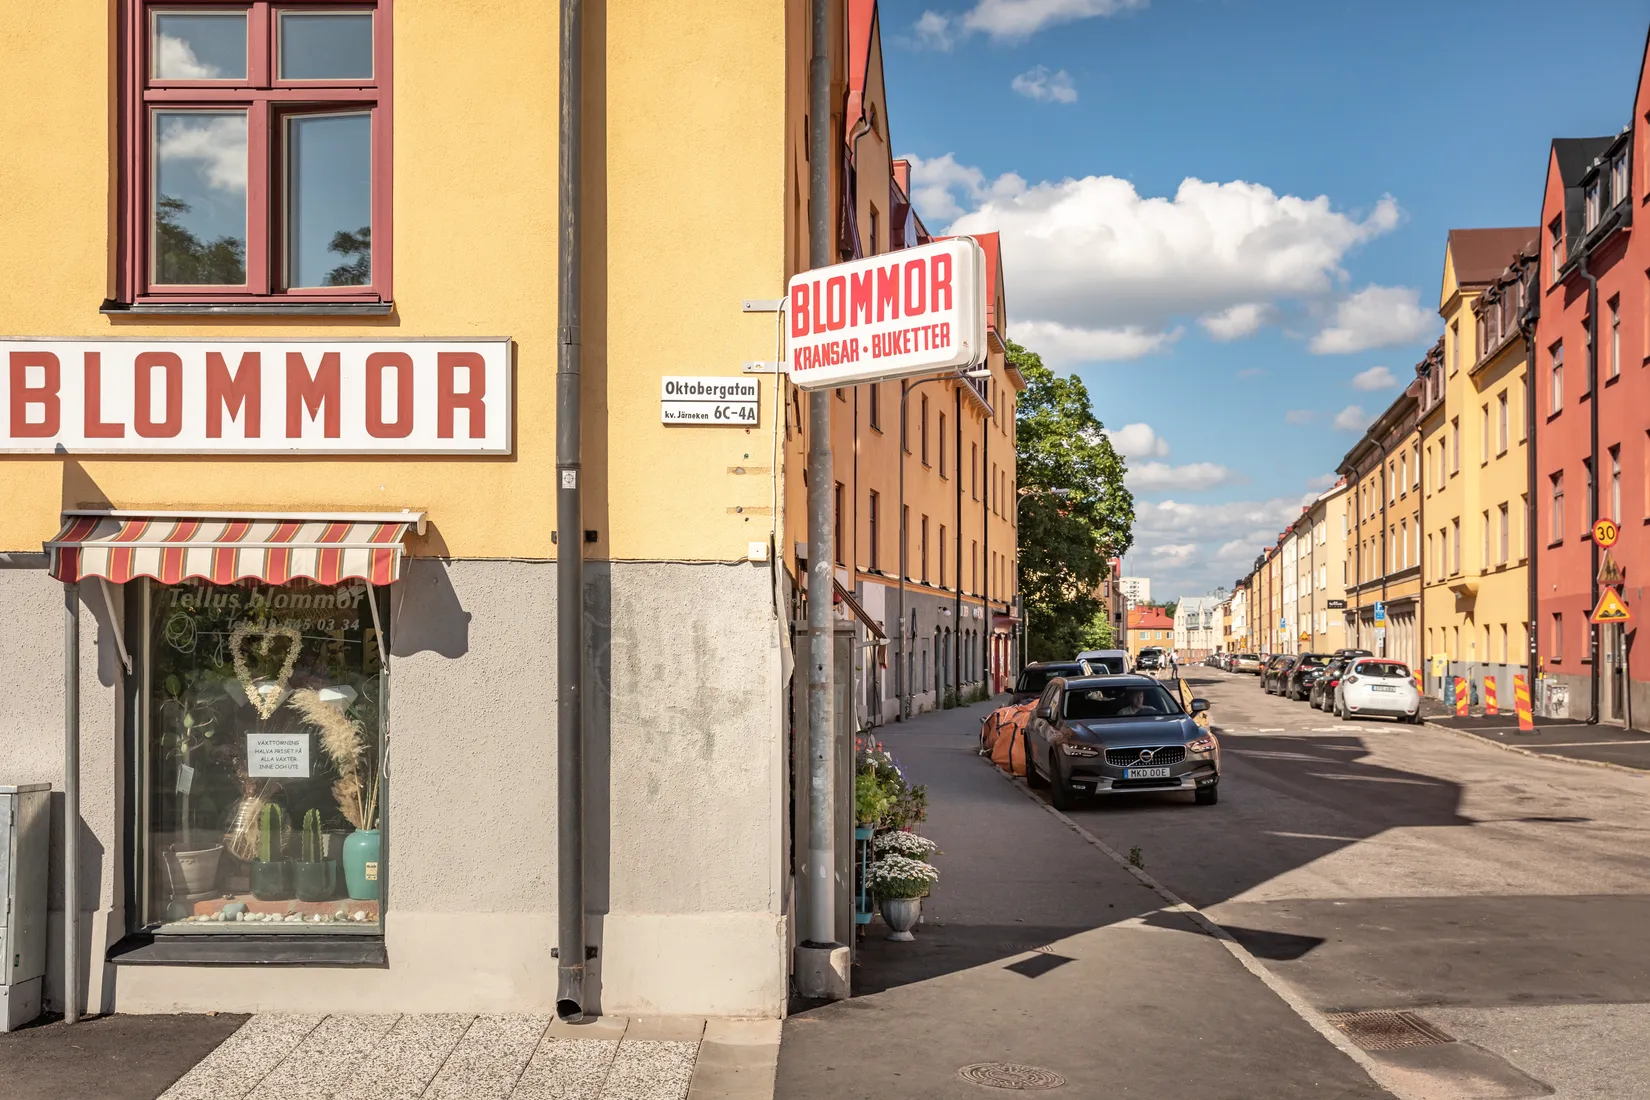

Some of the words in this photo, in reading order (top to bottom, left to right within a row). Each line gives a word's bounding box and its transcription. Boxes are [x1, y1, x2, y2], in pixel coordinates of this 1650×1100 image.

[791, 253, 953, 338] BLOMMOR
[793, 338, 859, 371] KRANSAR
[871, 322, 951, 359] BUKETTER
[9, 351, 486, 439] BLOMMOR
[665, 381, 755, 399] Oktobergatan
[664, 410, 676, 419] kv.
[677, 410, 709, 420] Järneken
[714, 405, 756, 421] 6C-4A
[1597, 526, 1615, 540] 30
[169, 586, 241, 608] Tellus
[317, 618, 335, 631] 03
[341, 618, 360, 631] 34
